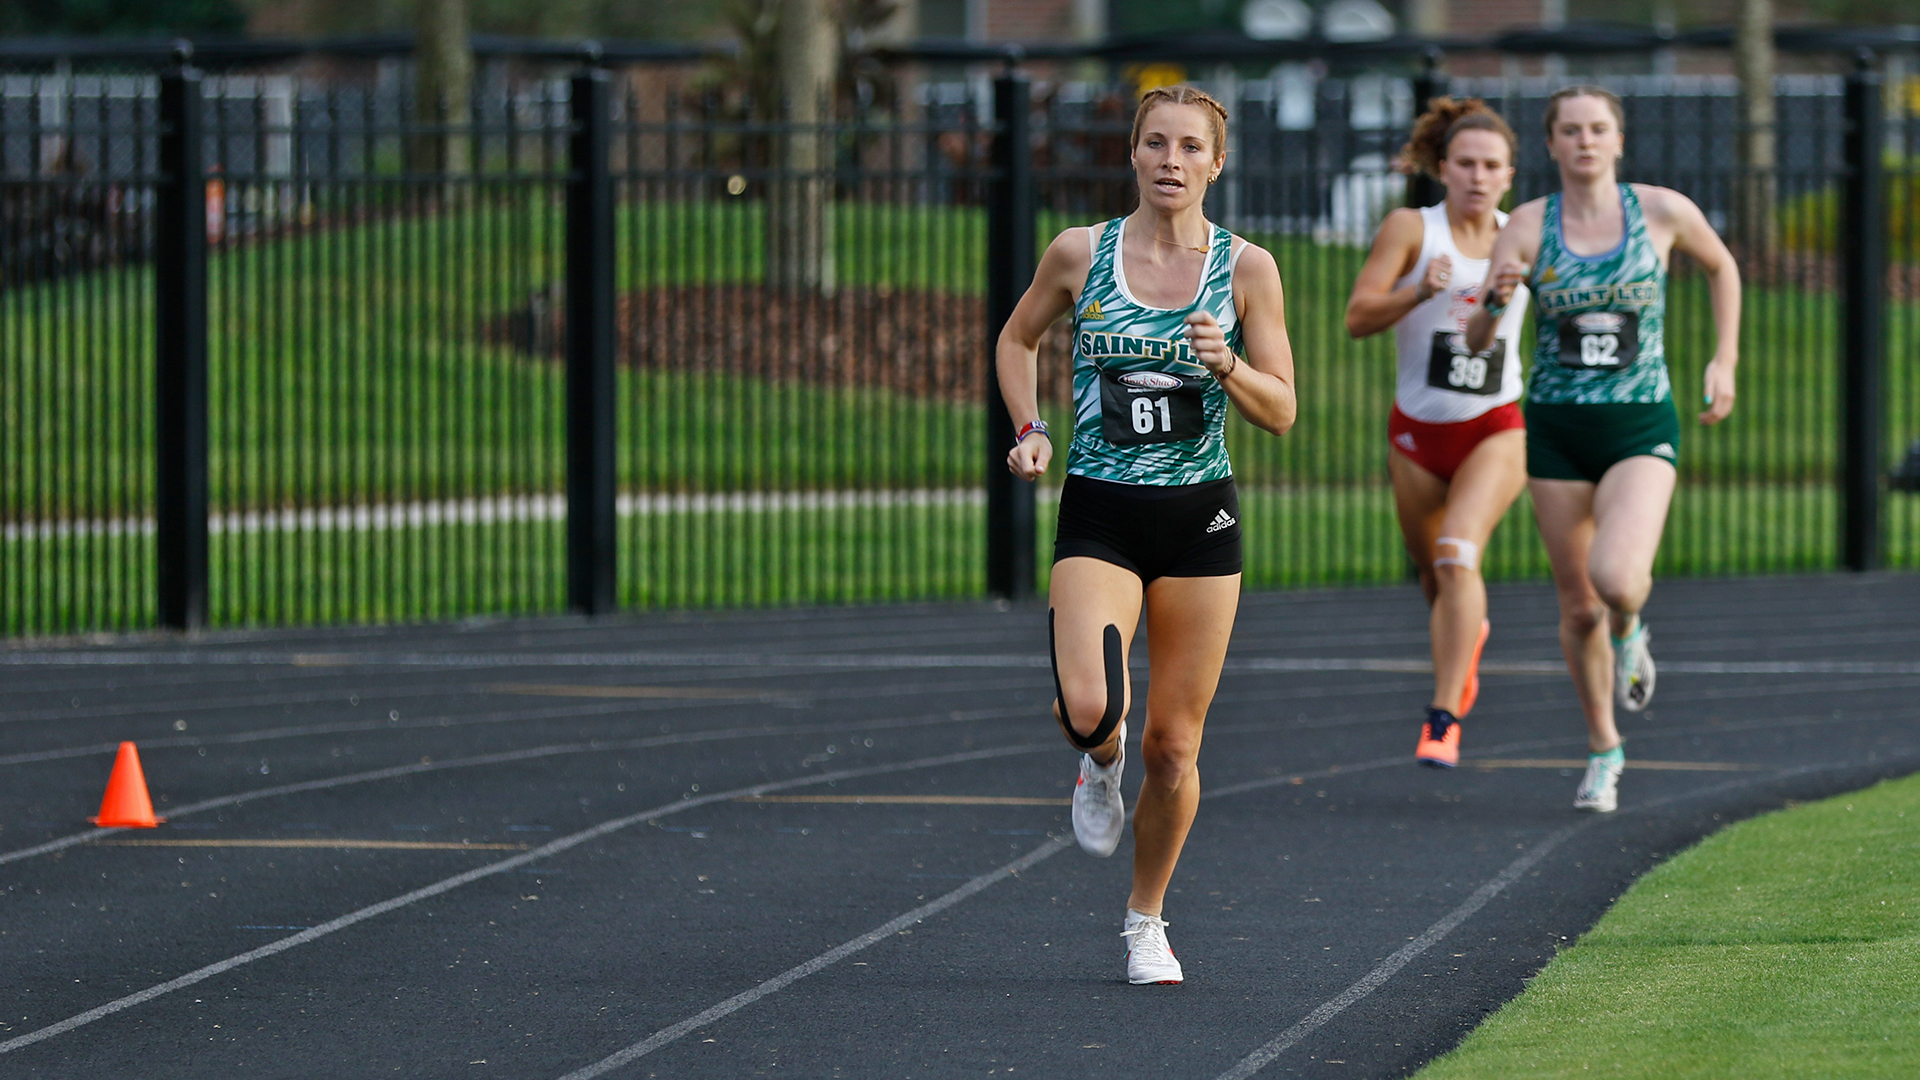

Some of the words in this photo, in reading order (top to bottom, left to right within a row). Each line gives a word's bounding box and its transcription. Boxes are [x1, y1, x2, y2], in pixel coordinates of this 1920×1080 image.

[1539, 284, 1612, 314] SAINT
[1080, 330, 1171, 360] SAINT
[1580, 333, 1619, 366] 62
[1149, 377, 1178, 387] Shack
[1448, 354, 1488, 389] 39
[1131, 396, 1172, 434] 61
[1206, 517, 1236, 534] adidas
